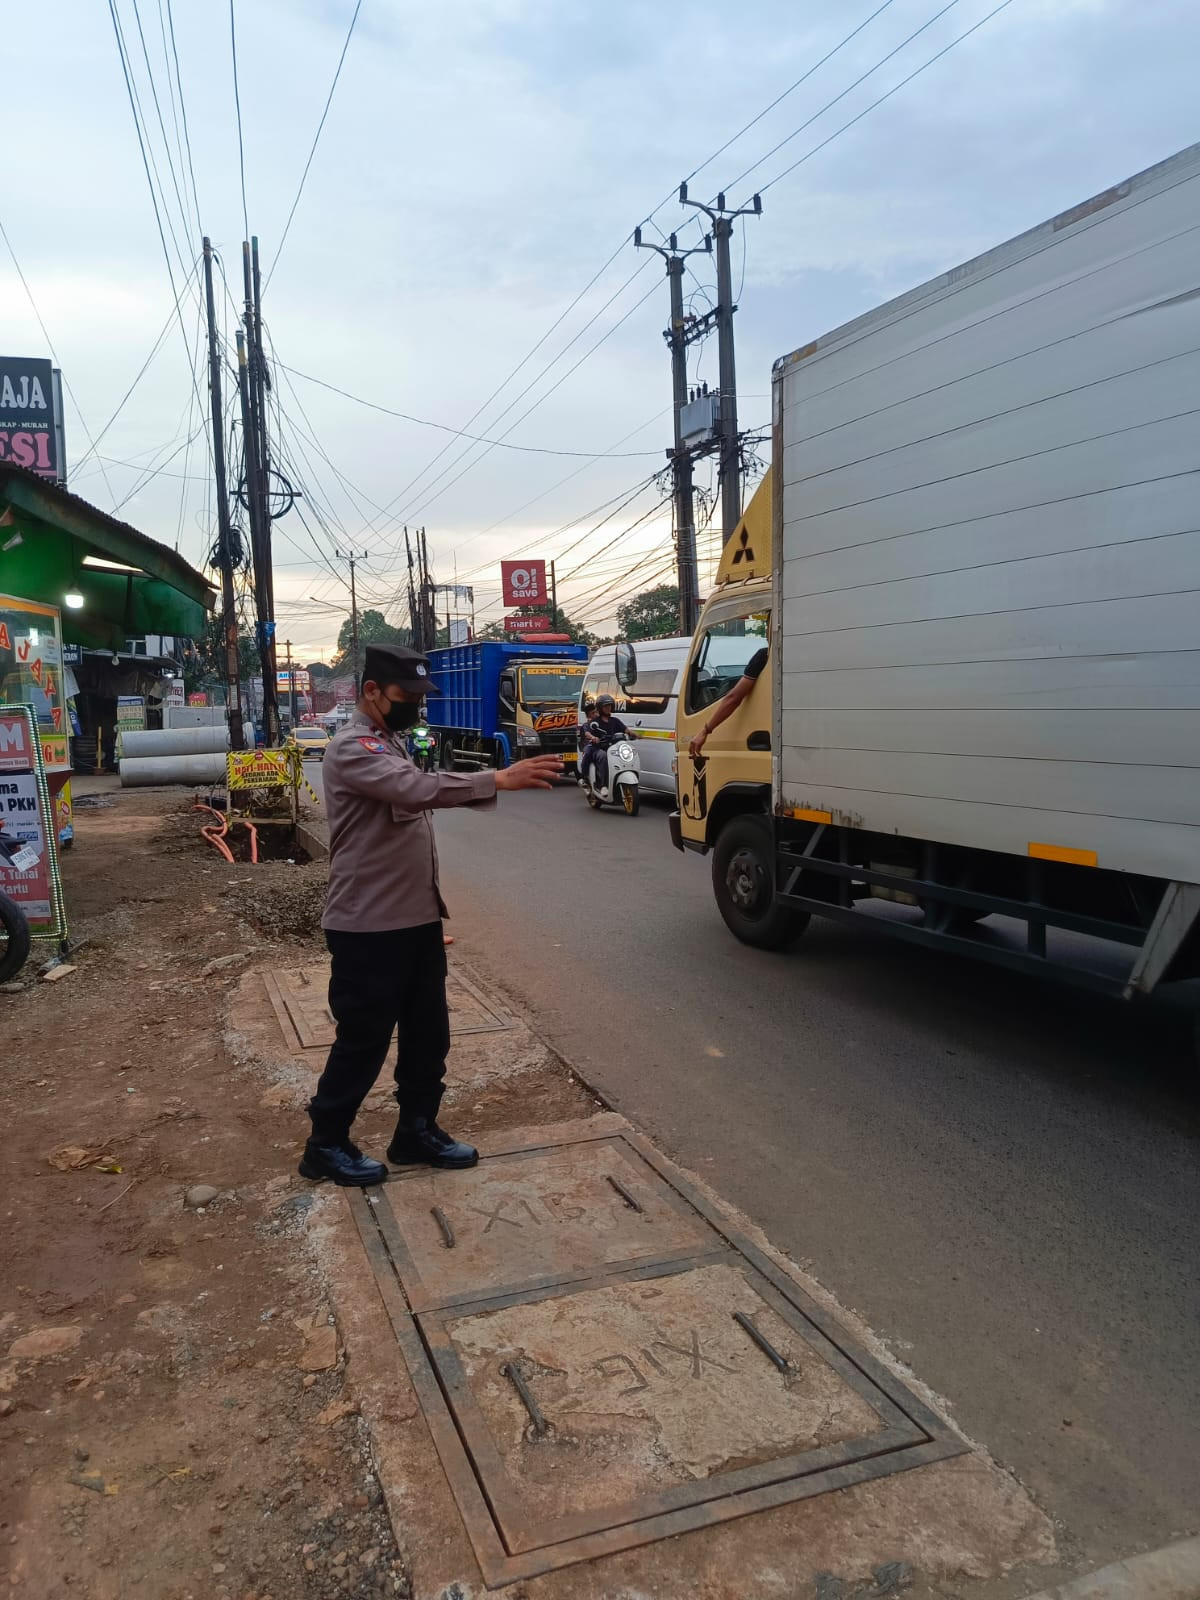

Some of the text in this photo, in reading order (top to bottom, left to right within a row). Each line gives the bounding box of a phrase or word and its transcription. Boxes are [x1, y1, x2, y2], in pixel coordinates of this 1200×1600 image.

[0, 375, 47, 409] AJA
[512, 589, 539, 598] save
[7, 797, 37, 812] PKH
[8, 868, 39, 880] Tunai
